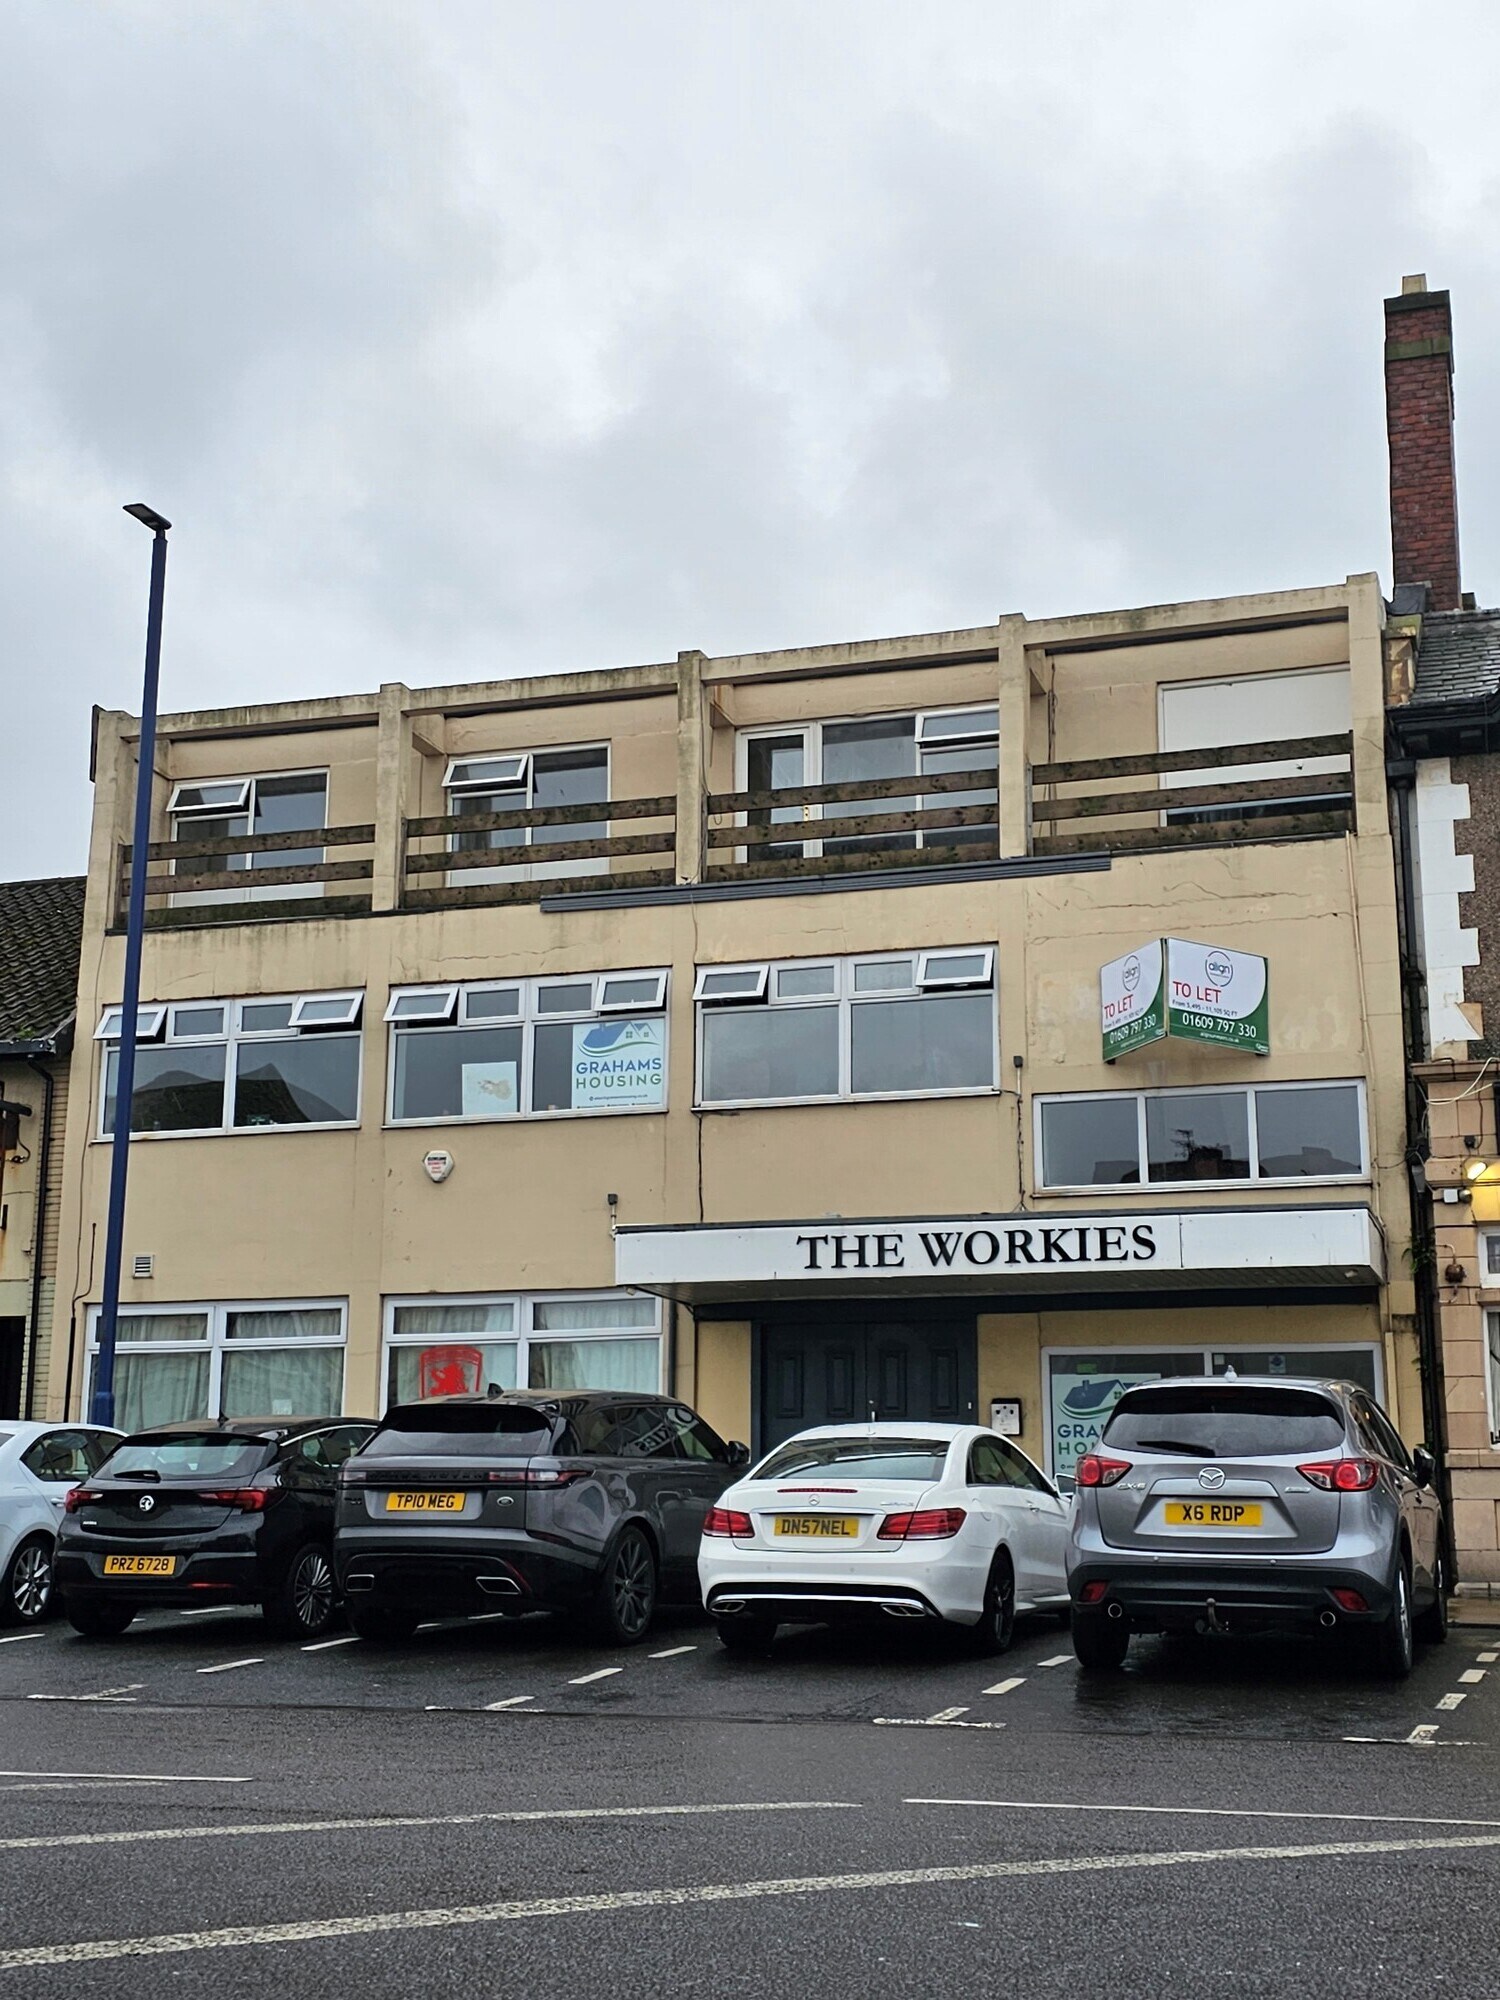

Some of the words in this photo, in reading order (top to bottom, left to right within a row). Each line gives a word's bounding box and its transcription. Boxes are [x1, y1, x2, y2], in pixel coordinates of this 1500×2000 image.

[1172, 981, 1192, 998] TO
[1196, 986, 1222, 1004] LET
[1104, 1001, 1116, 1020] TO
[1117, 994, 1134, 1014] LET
[1130, 1019, 1142, 1036] 797
[1143, 1013, 1156, 1030] 330
[1182, 1013, 1213, 1029] 01609
[1216, 1019, 1235, 1034] 797
[1238, 1023, 1257, 1038] 330
[576, 1058, 662, 1075] GRAHAMS
[576, 1074, 662, 1089] HOUSING
[796, 1234, 904, 1270] THE
[919, 1224, 1156, 1267] WORKIES
[428, 1494, 456, 1509] MEG
[1182, 1505, 1204, 1521] X6
[1210, 1506, 1245, 1522] RDP
[110, 1557, 135, 1571] PRZ
[138, 1557, 169, 1571] 6728
